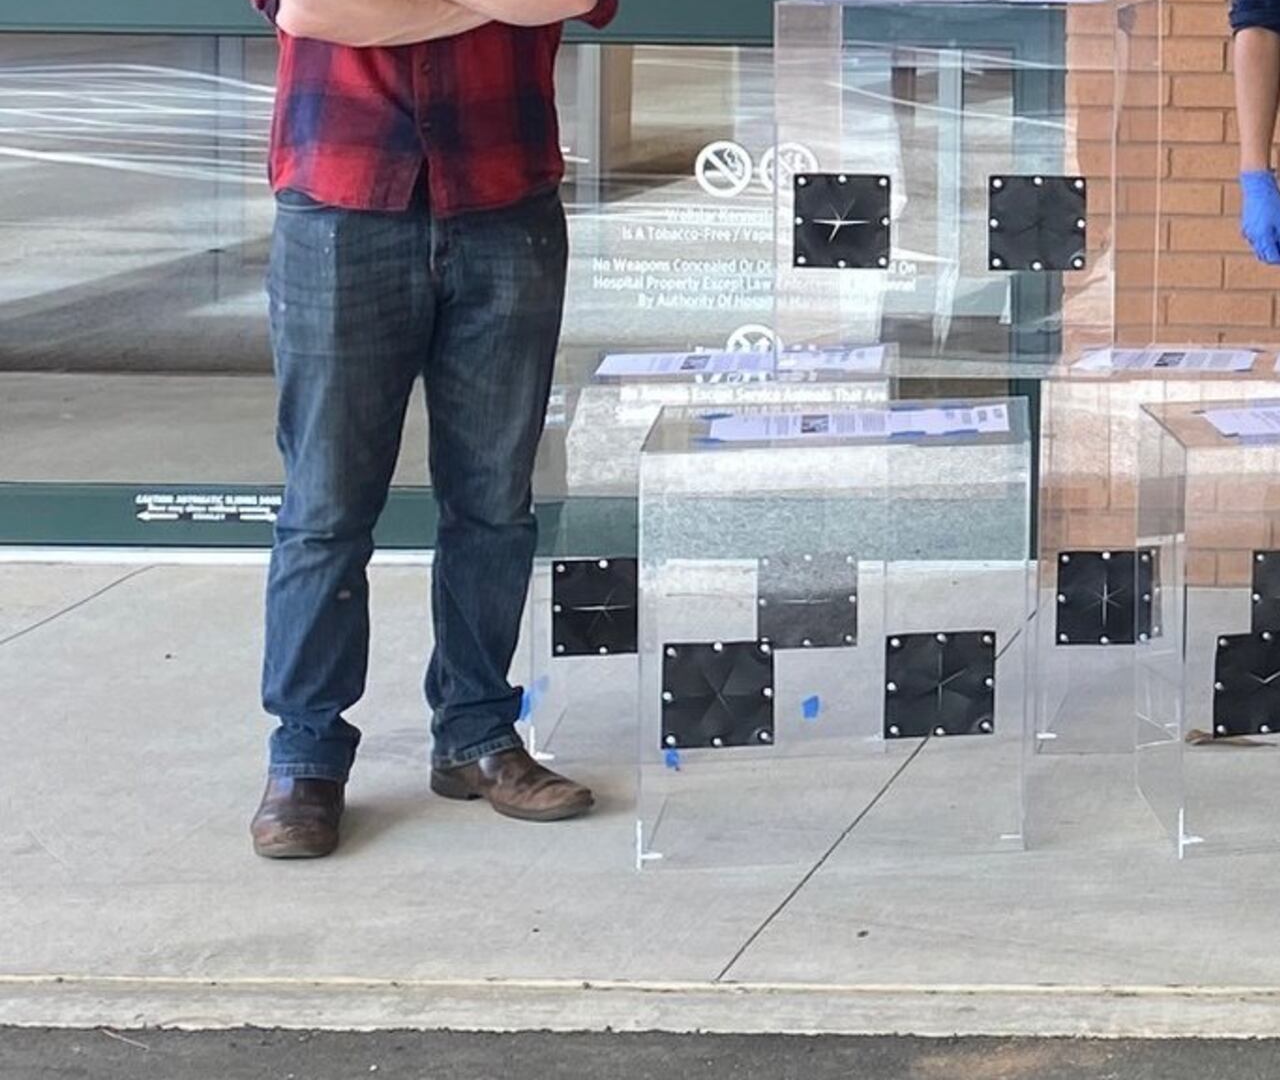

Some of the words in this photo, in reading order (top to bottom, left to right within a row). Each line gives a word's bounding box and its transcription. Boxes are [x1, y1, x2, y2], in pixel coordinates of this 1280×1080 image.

[635, 227, 645, 240] A
[593, 257, 611, 272] No
[613, 258, 670, 273] Weapons
[673, 258, 736, 273] Concealed
[593, 275, 644, 291] Hospital
[646, 275, 700, 291] Property
